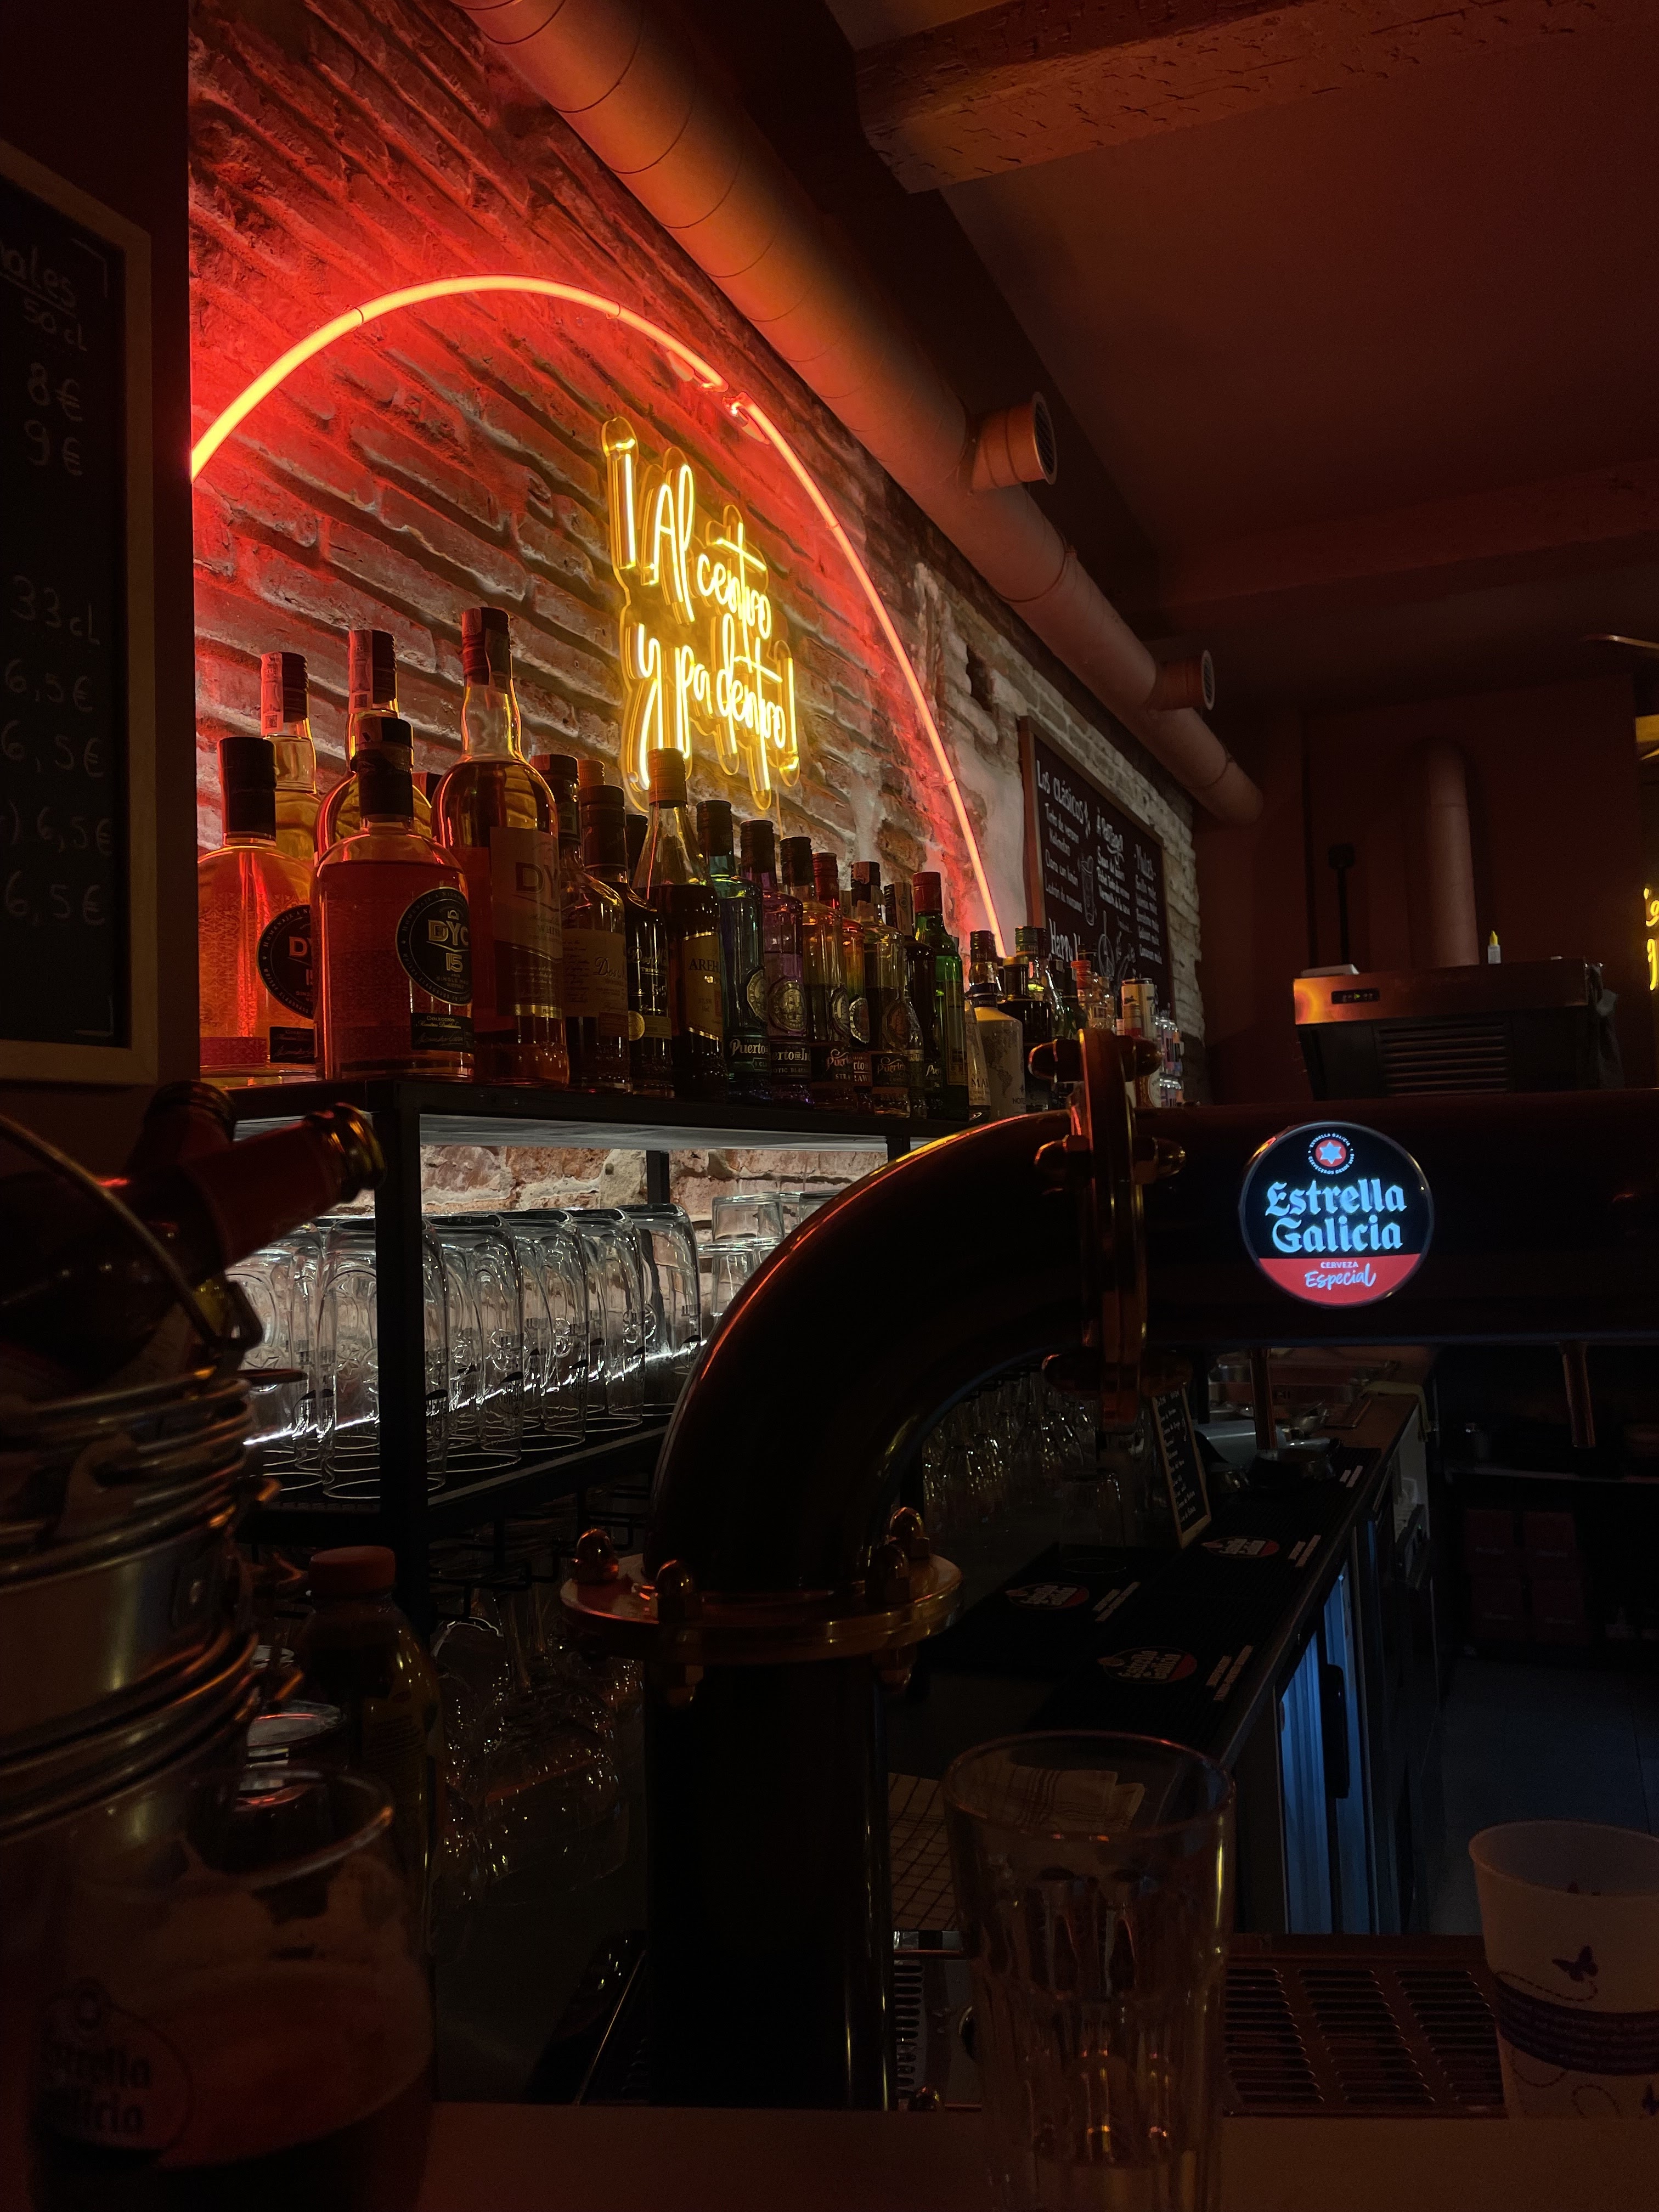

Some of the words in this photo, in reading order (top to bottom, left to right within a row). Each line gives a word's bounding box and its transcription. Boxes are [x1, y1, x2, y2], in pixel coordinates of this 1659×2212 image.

[0, 237, 77, 308] ales
[697, 521, 772, 673] centro
[445, 952, 464, 973] 15
[688, 958, 718, 973] AREH
[729, 1038, 766, 1057] Puerto
[1265, 1178, 1408, 1217] Estrella
[1272, 1214, 1403, 1253] Galicia
[1304, 1263, 1376, 1290] Especial
